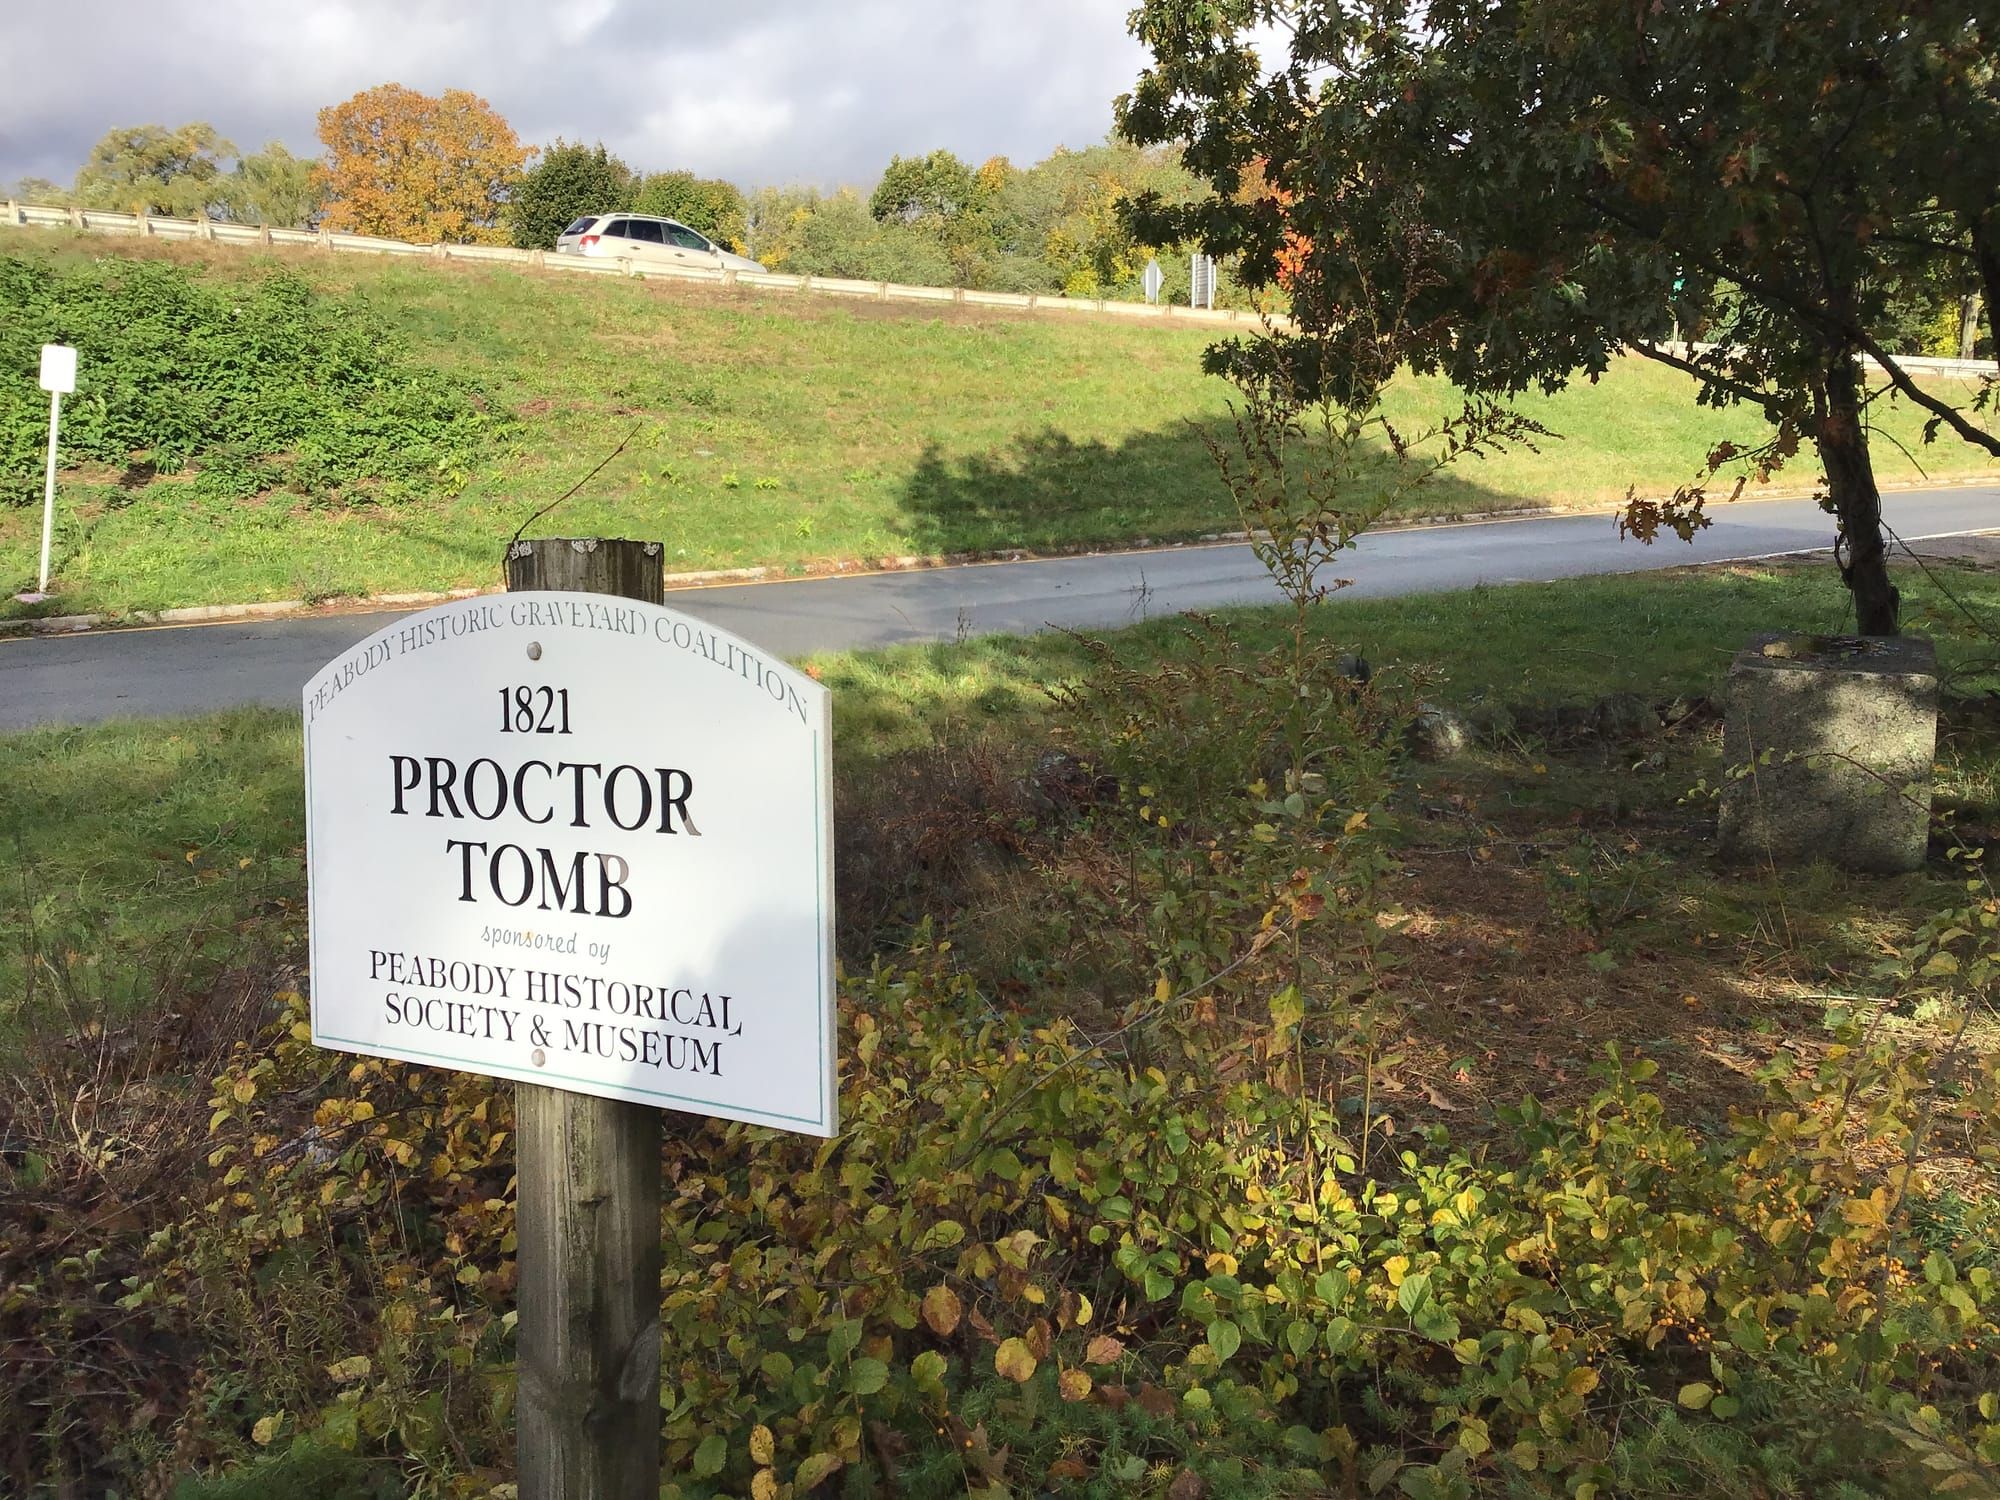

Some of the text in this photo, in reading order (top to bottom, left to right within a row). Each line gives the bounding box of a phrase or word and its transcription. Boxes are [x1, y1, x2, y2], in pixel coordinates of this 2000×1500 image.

[308, 601, 807, 725] PEABODY HISTORIC GRAVEYARD COALITION
[499, 685, 573, 735] 1821
[389, 755, 702, 837] PROCTOR
[446, 839, 632, 919] TOMB
[481, 925, 577, 954] sponsored
[369, 950, 743, 1036] PEABODY HISTORICAL
[385, 992, 723, 1076] SOCIETY & MUSEUM
